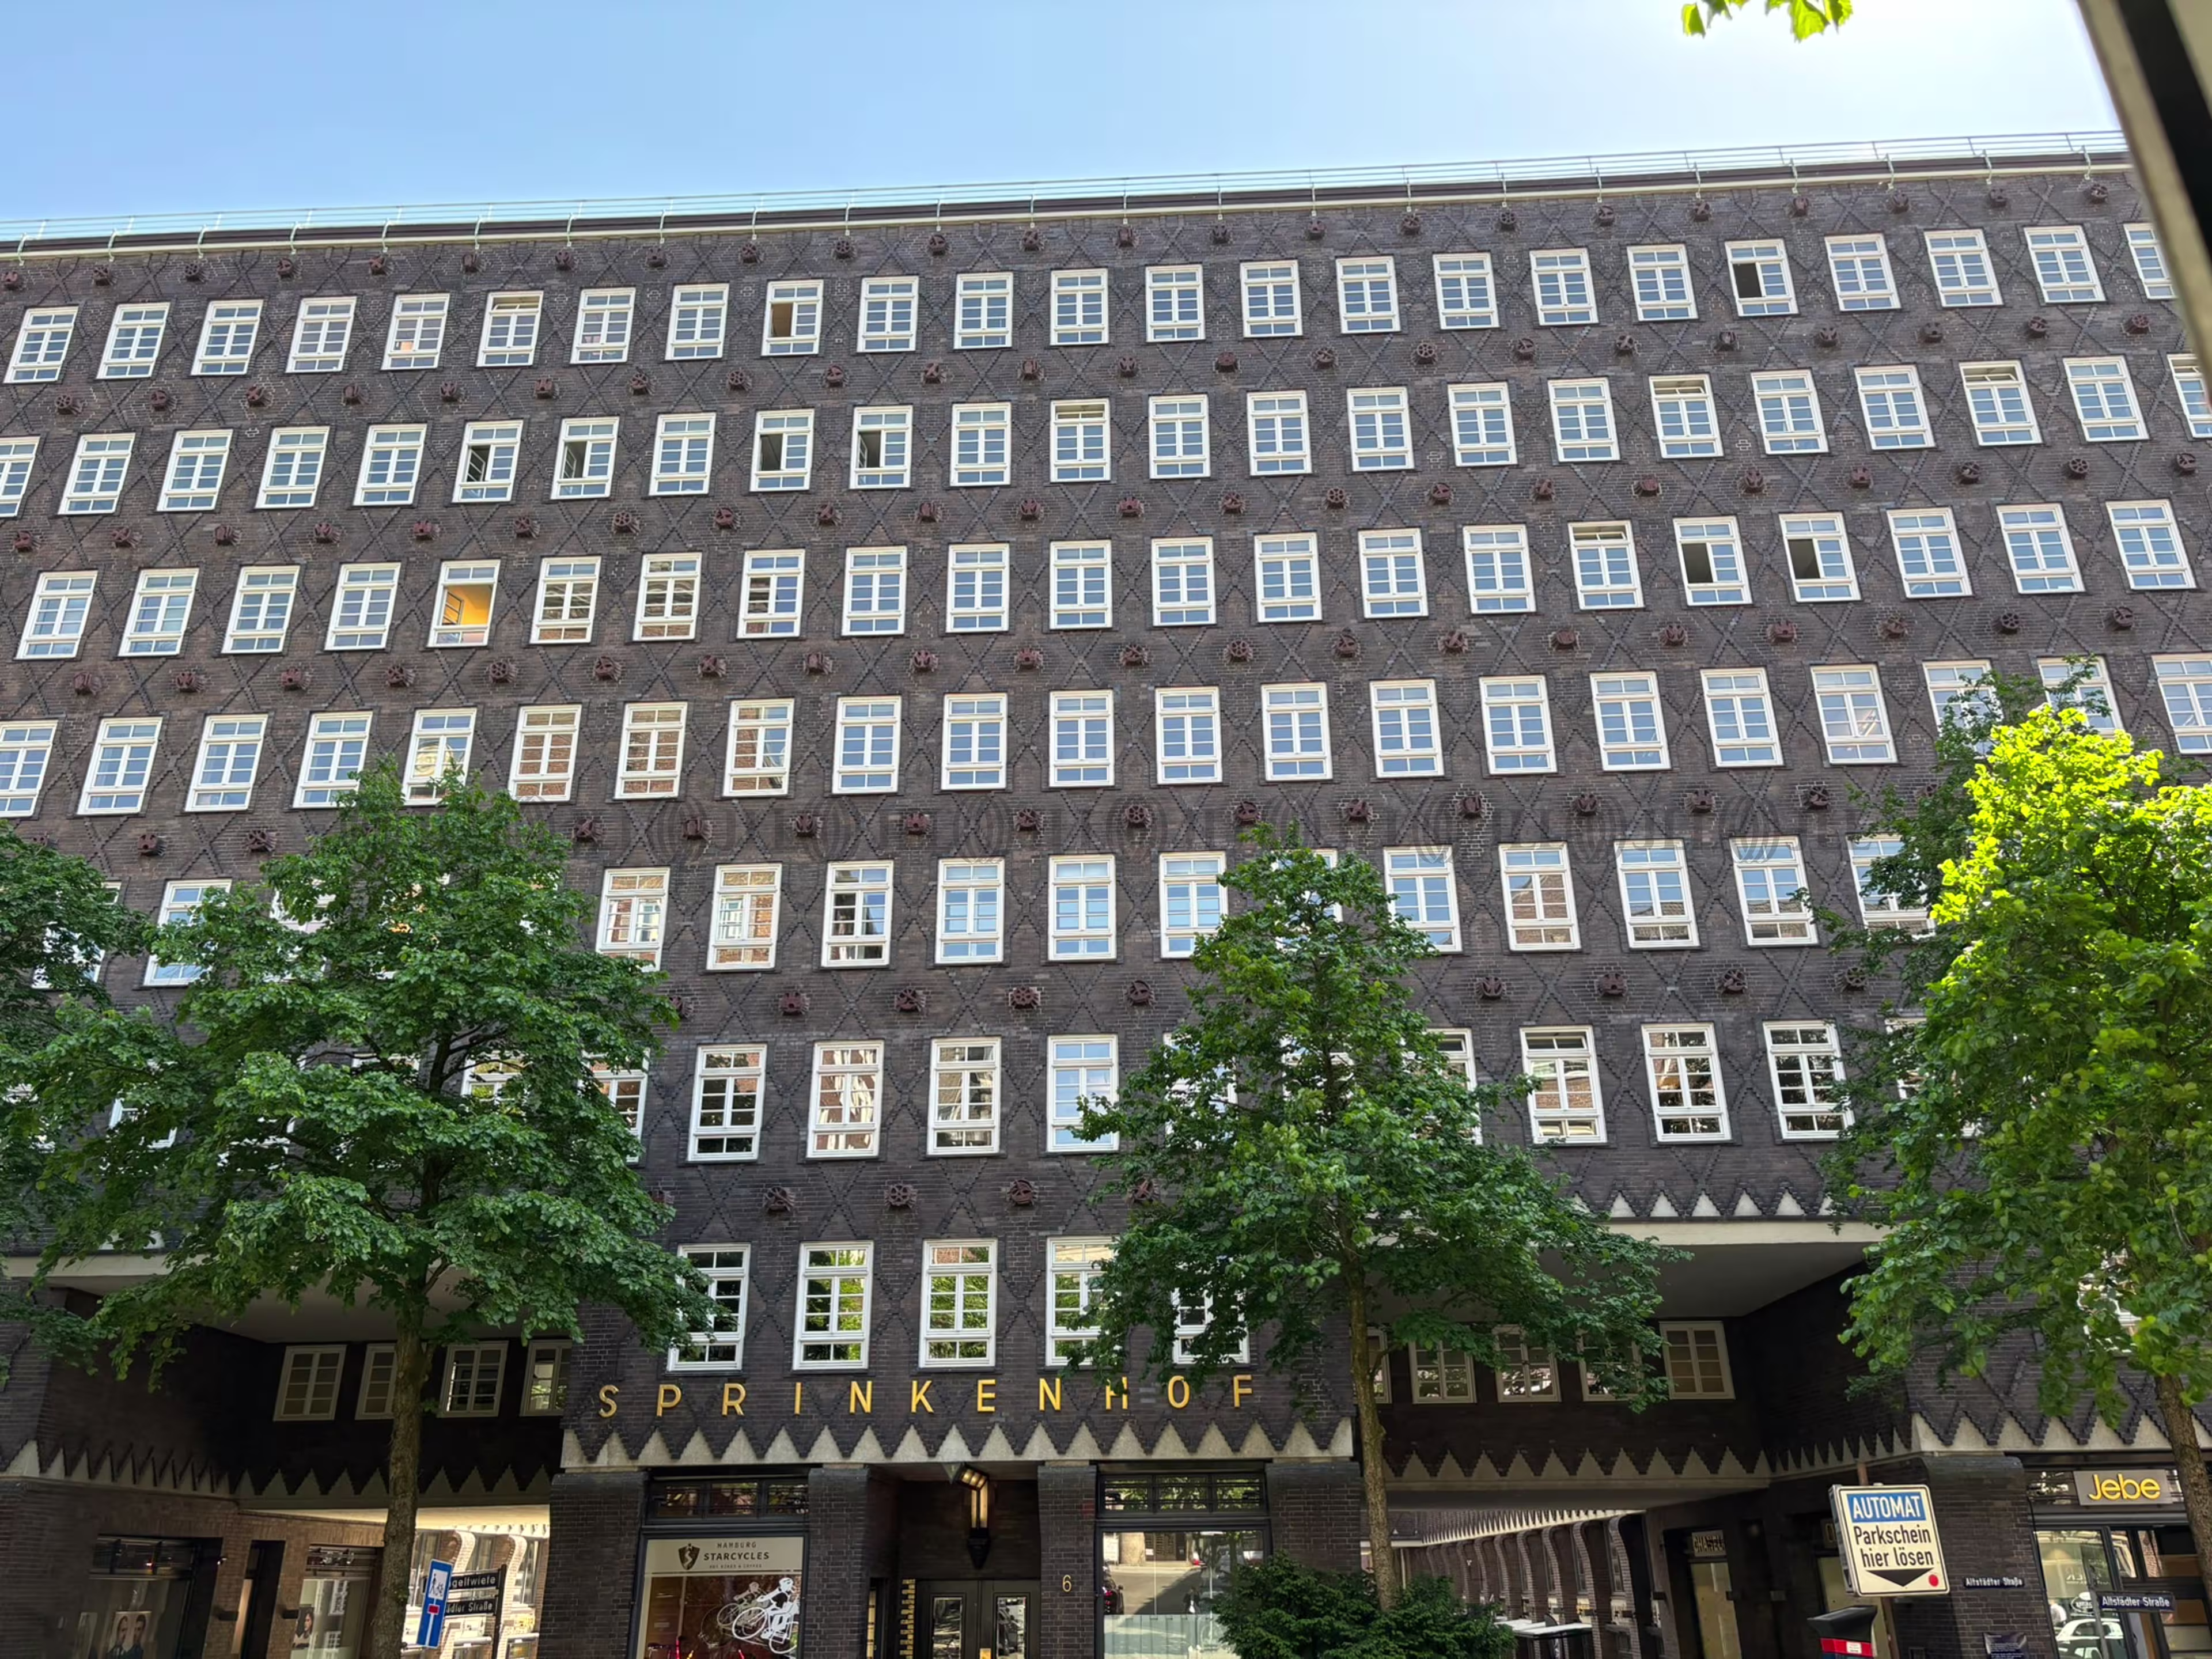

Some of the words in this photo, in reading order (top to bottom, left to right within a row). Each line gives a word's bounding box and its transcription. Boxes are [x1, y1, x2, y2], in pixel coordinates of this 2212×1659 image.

[599, 1374, 1252, 1418] SPRINKENHOF
[2088, 1473, 2160, 1500] Jebe
[1853, 1495, 1921, 1519] AUTOMAT
[1853, 1524, 1931, 1545] Parkschein
[717, 1541, 756, 1549] HAMBURG
[703, 1551, 770, 1560] STARCYCLES
[1860, 1547, 1889, 1567] hier
[1893, 1547, 1934, 1566] lösen
[1062, 1574, 1072, 1592] 6
[2102, 1595, 2141, 1607] Altstädter
[2142, 1596, 2171, 1607] Straße
